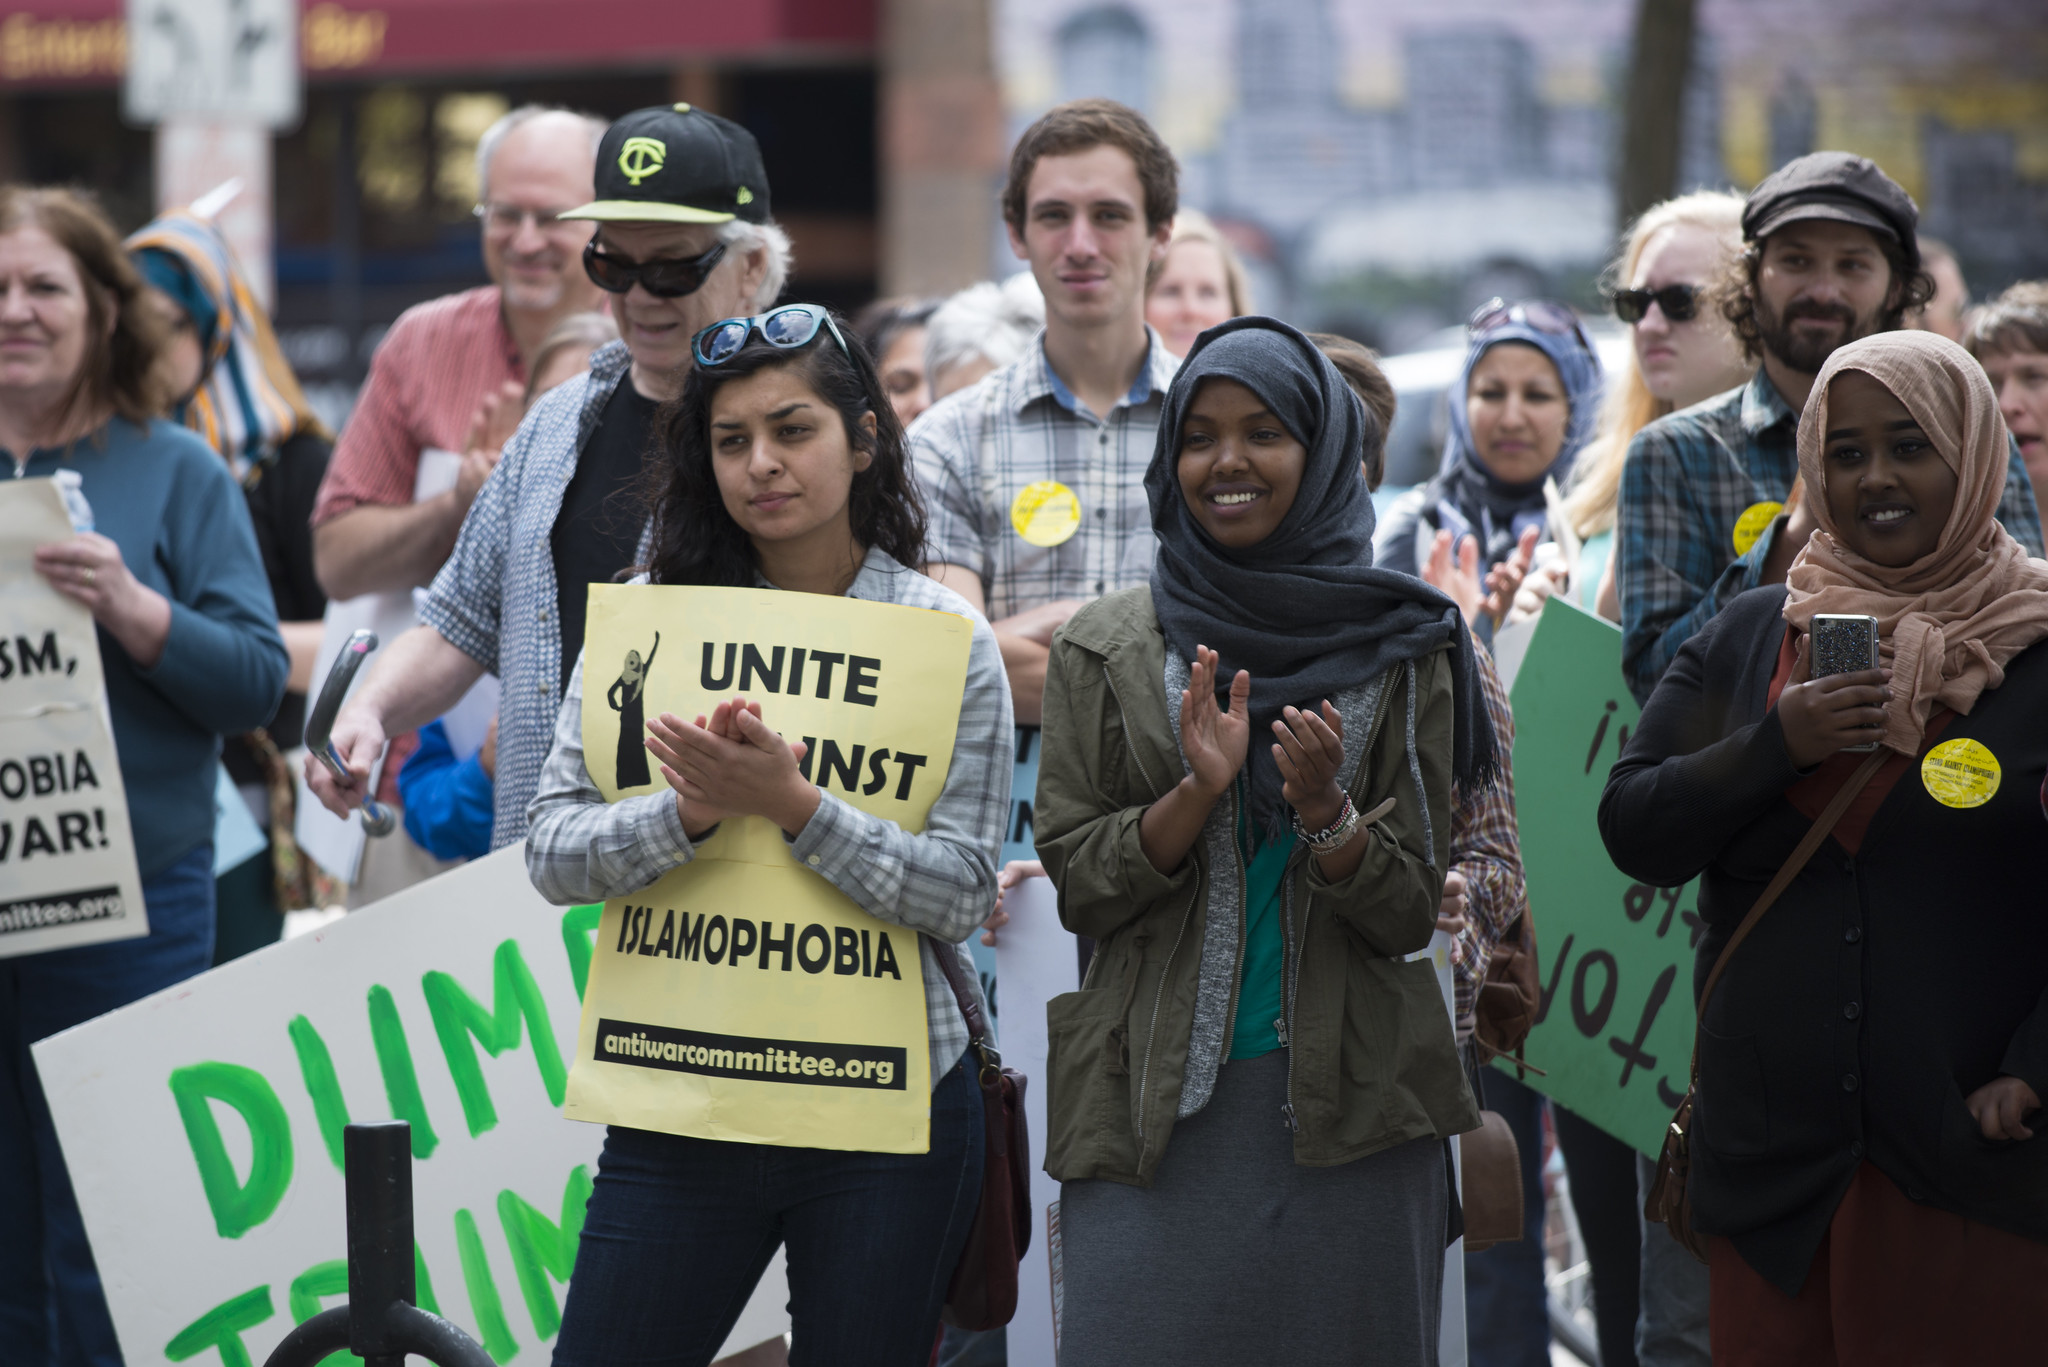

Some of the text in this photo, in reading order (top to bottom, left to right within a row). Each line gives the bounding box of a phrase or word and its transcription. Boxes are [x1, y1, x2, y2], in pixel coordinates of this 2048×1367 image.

[700, 641, 881, 707] UNITE
[777, 732, 928, 801] INST
[1944, 759, 1963, 771] AGAINST
[617, 905, 902, 980] ISLAMOPHOBIA
[604, 1032, 895, 1084] antiwarcommittee.org
